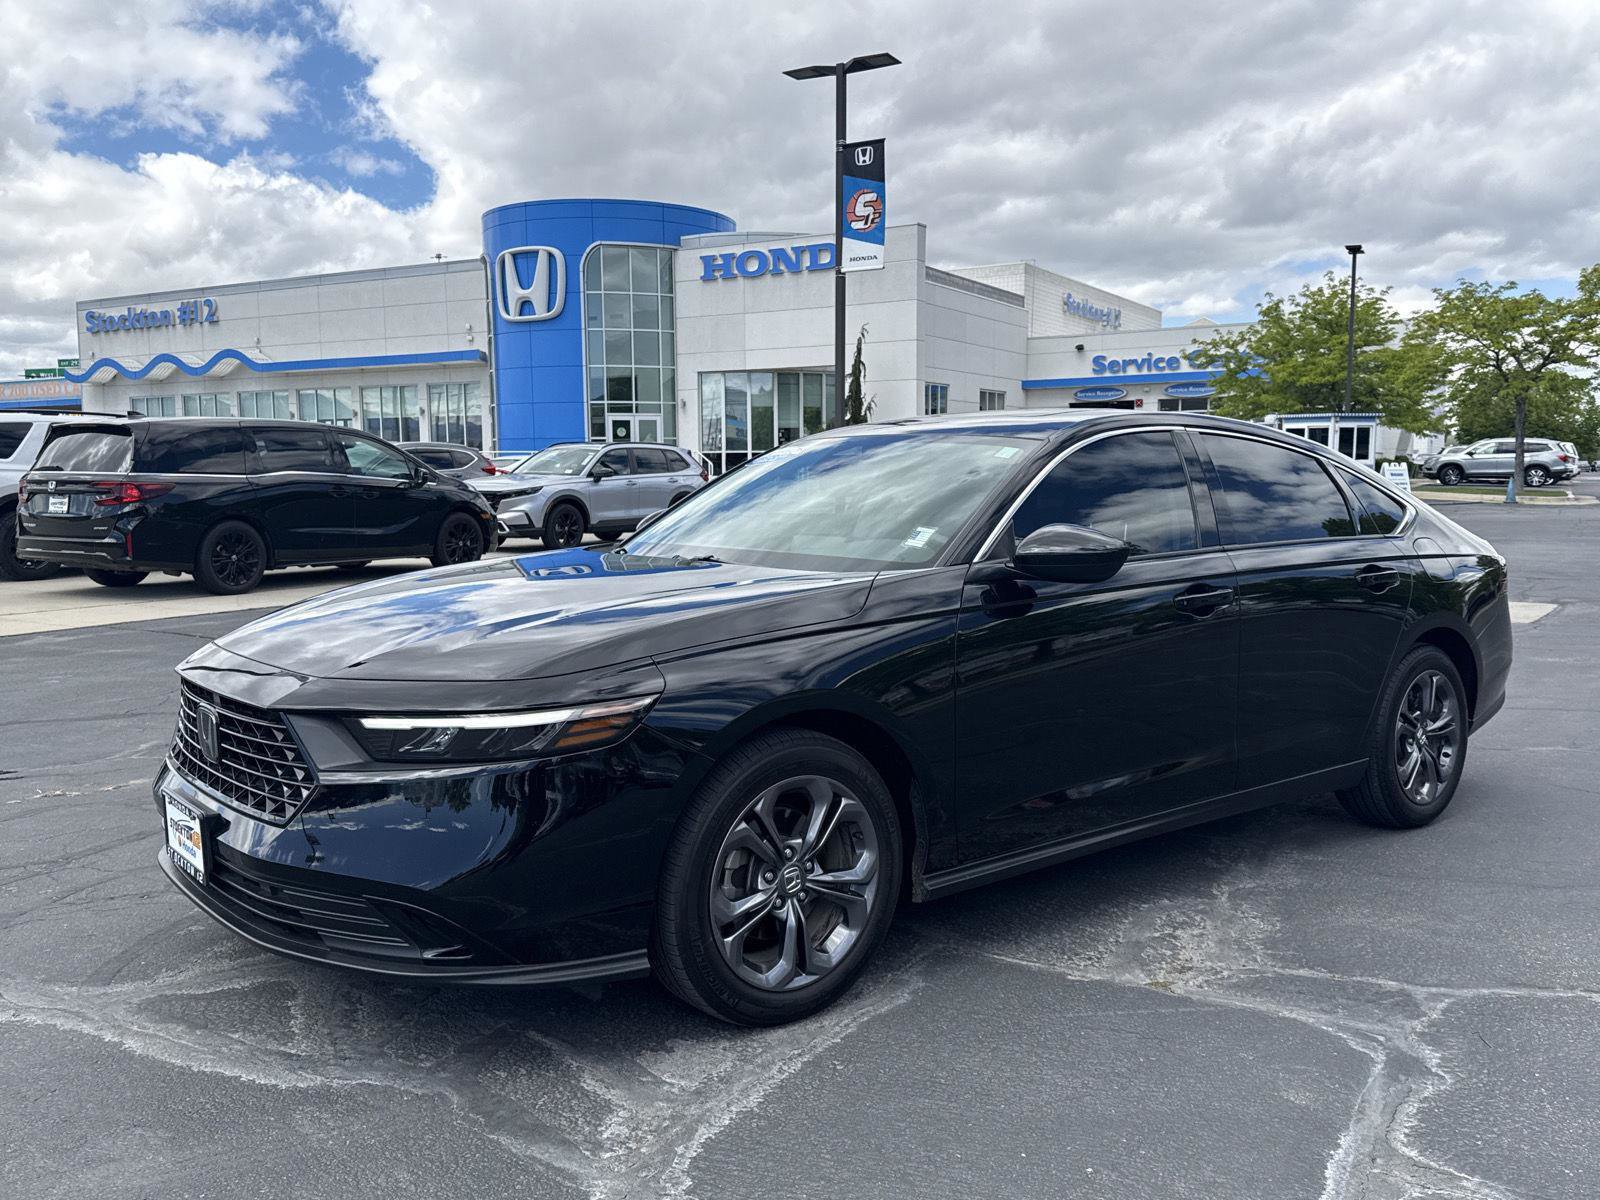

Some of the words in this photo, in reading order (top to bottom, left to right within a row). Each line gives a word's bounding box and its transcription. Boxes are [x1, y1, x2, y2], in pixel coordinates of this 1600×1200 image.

[699, 242, 836, 281] HOND
[849, 254, 878, 262] HONDA
[85, 306, 173, 333] Stockton
[177, 298, 216, 326] #12
[1091, 351, 1181, 375] Service
[167, 846, 195, 877] STOCKTON
